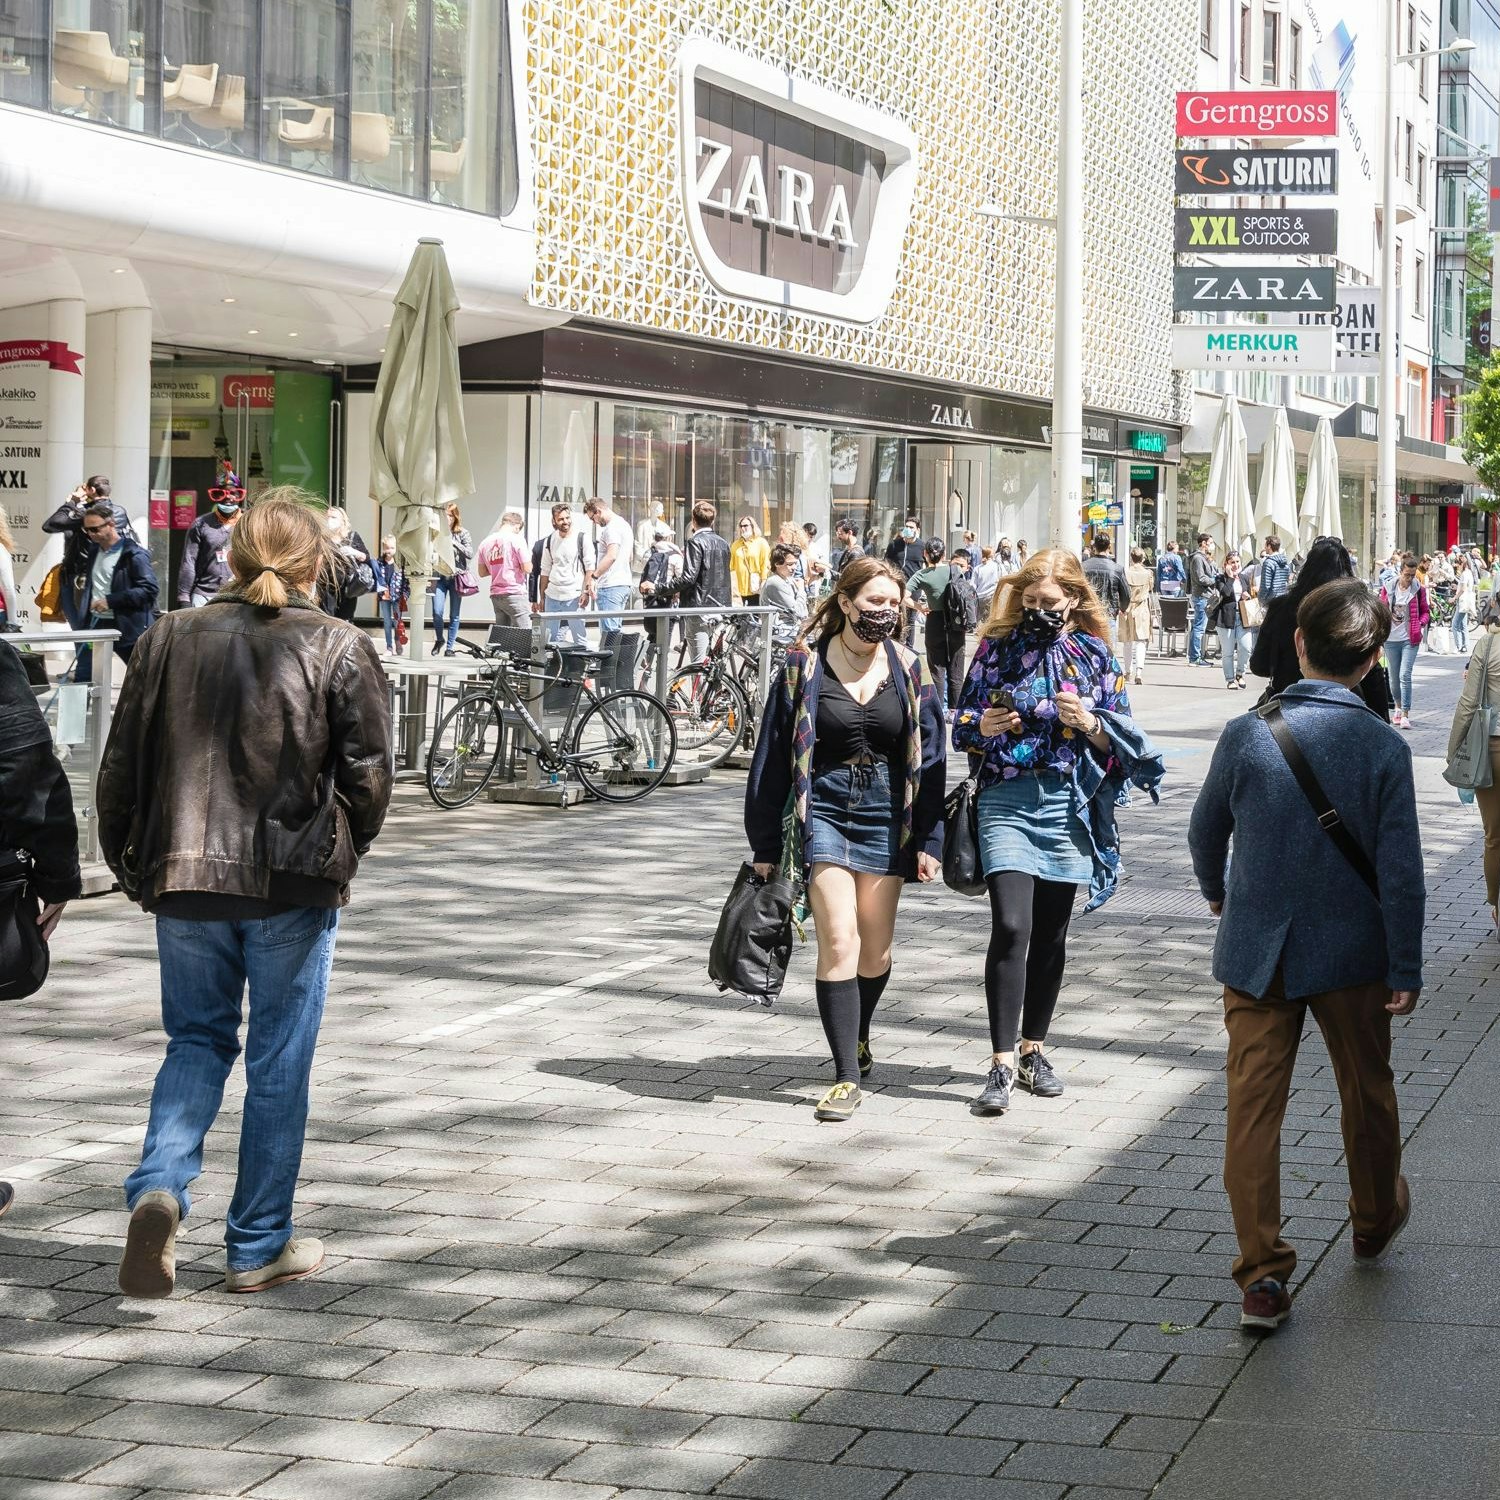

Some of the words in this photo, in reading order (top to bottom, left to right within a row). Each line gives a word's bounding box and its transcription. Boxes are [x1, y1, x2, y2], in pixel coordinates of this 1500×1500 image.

[1185, 96, 1329, 131] Gerngross
[1232, 156, 1332, 186] SATURN
[696, 135, 859, 248] ZARA
[1189, 216, 1240, 246] XXL
[1243, 216, 1291, 230] SPORTS
[1294, 216, 1304, 230] &
[1242, 232, 1310, 246] OUTDOOR
[1192, 277, 1324, 301] ZARA
[1207, 333, 1299, 351] MERKUR
[1206, 354, 1232, 363] Ihr
[1247, 354, 1299, 363] Markt
[179, 382, 200, 390] WELT
[931, 403, 974, 430] ZARA
[5, 446, 41, 458] SATURN
[536, 484, 587, 503] ZARA
[1418, 495, 1443, 504] Street
